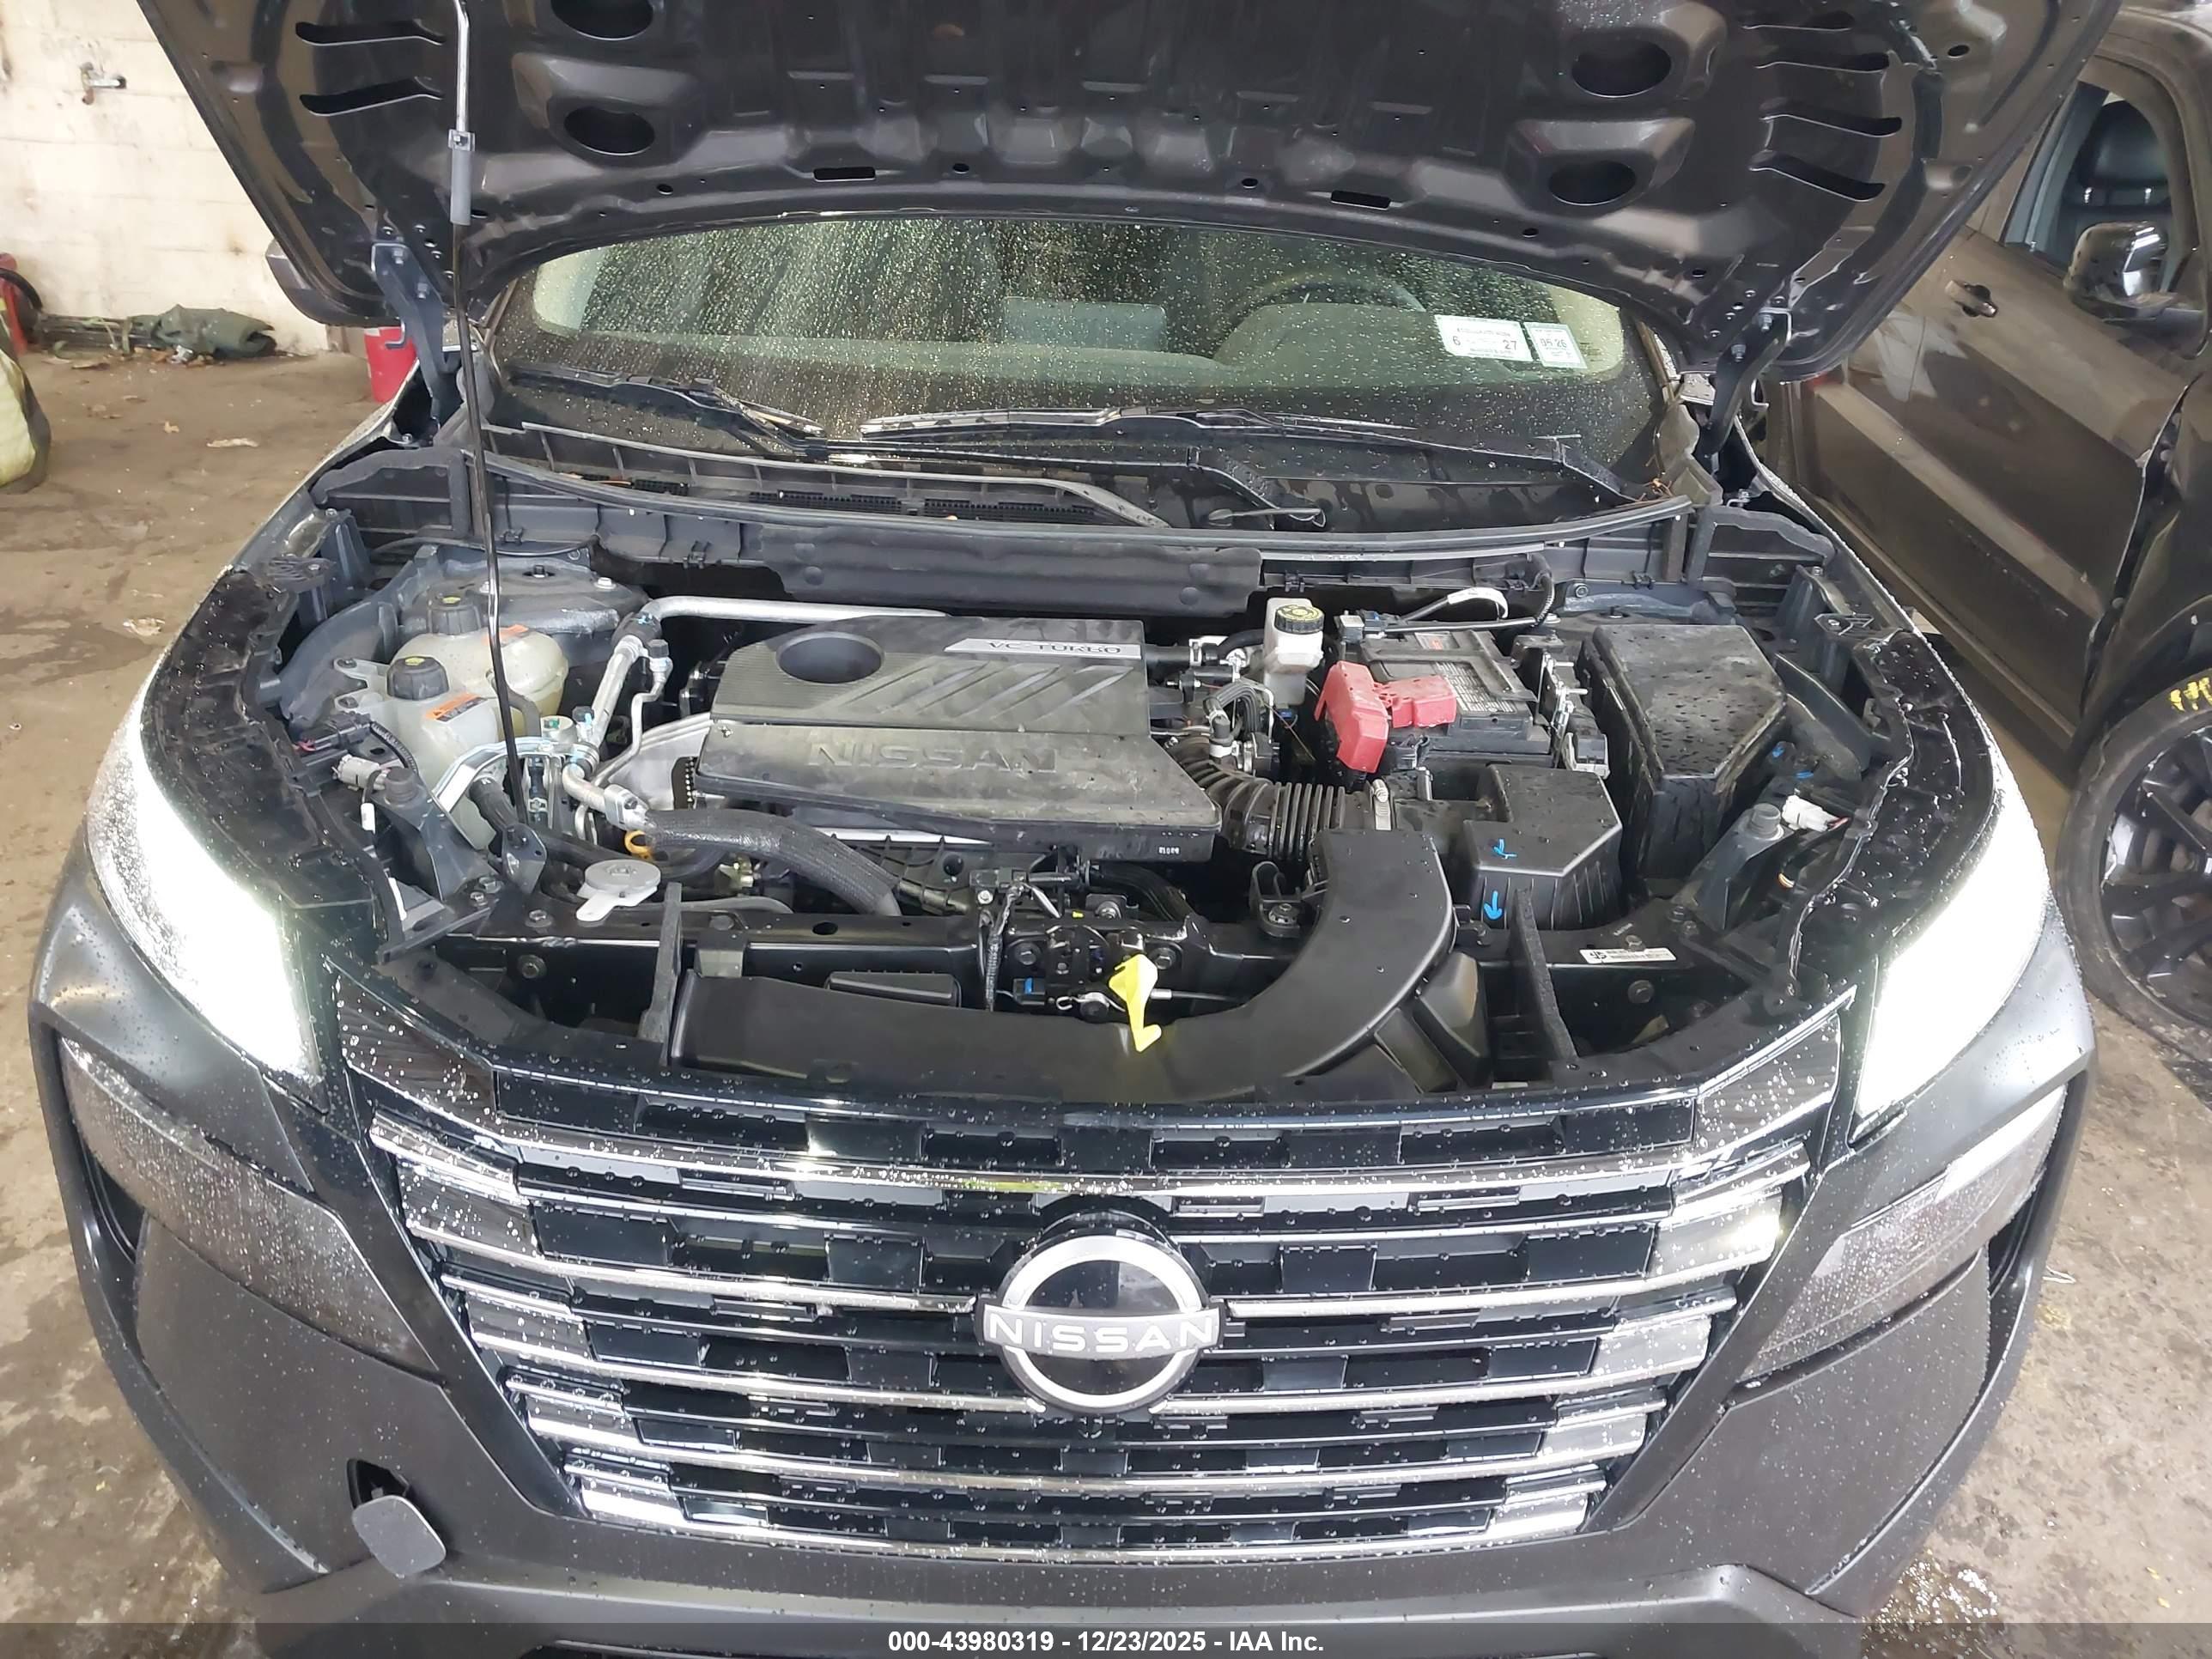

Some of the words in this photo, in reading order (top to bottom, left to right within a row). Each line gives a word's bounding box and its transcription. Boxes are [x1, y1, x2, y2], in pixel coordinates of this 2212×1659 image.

[1503, 339, 1517, 350] 27
[805, 742, 1057, 774] NISSAN
[989, 1313, 1212, 1353] NISSAN
